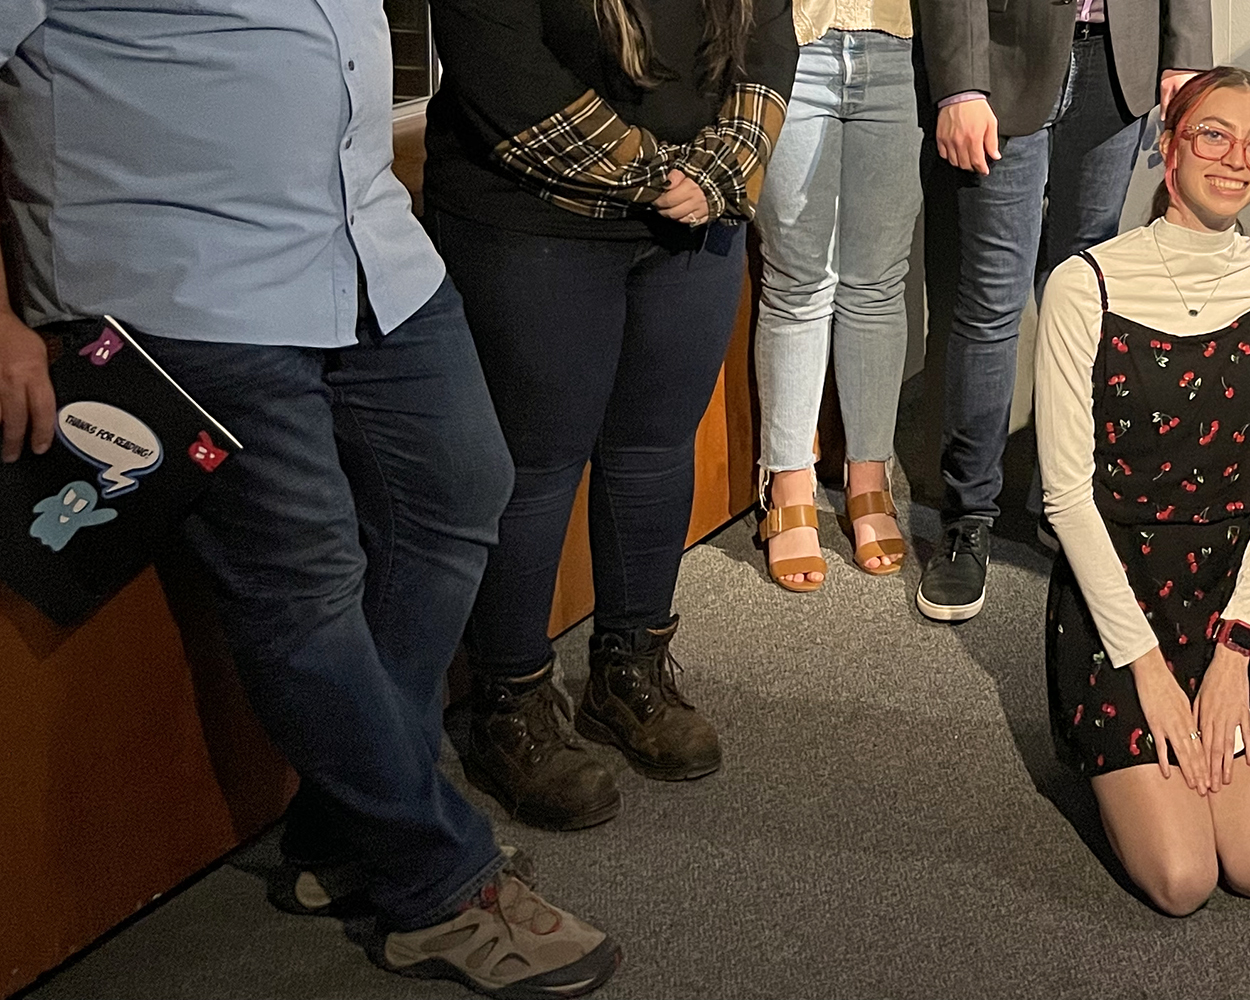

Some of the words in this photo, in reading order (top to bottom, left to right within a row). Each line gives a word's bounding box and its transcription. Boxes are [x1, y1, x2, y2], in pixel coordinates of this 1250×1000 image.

[65, 414, 97, 434] THANKS
[96, 429, 115, 442] FOR
[113, 436, 154, 459] READING!
